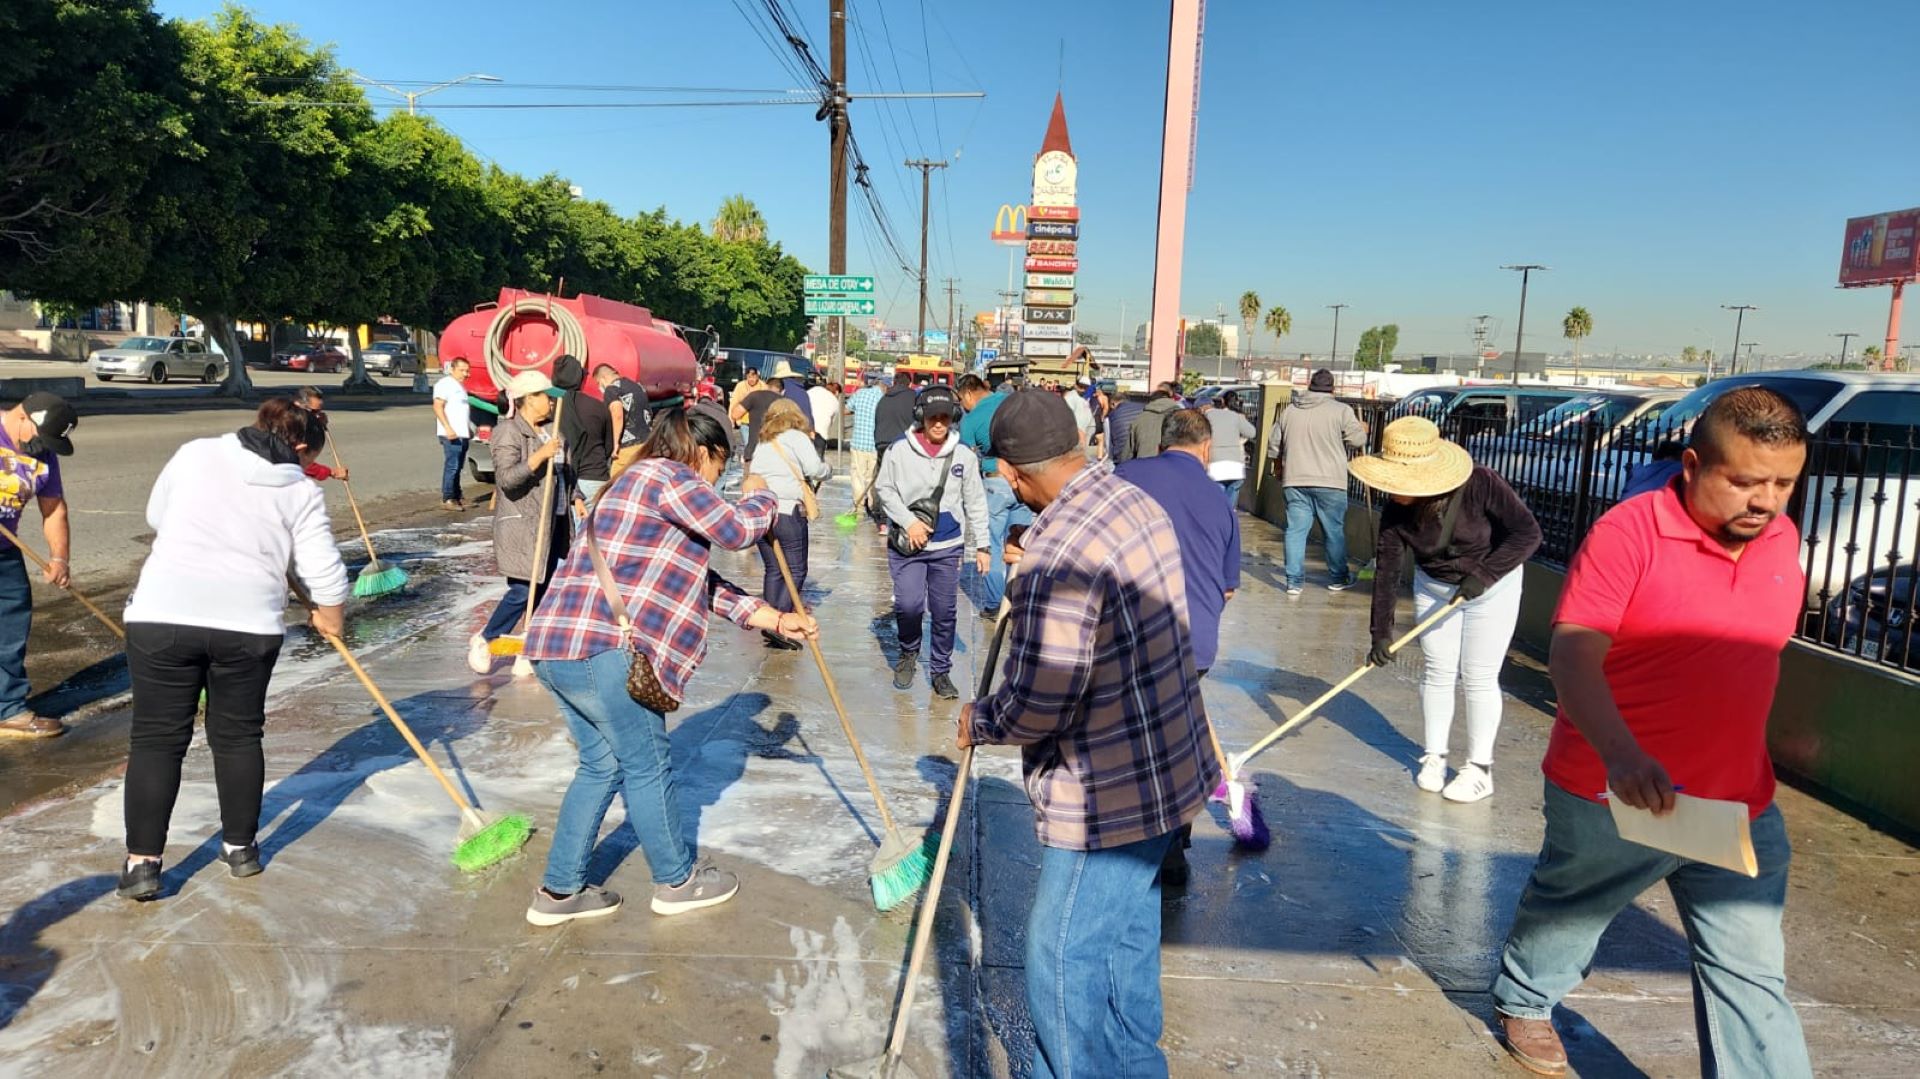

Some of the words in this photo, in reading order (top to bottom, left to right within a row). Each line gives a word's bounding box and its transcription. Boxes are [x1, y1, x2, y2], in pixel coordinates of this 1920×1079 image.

[1034, 223, 1072, 235] cinépolis
[1036, 260, 1078, 268] BANORTE
[806, 278, 827, 290] MESA
[828, 278, 840, 290] DE
[840, 278, 858, 290] OTAY
[1032, 310, 1065, 319] DAX
